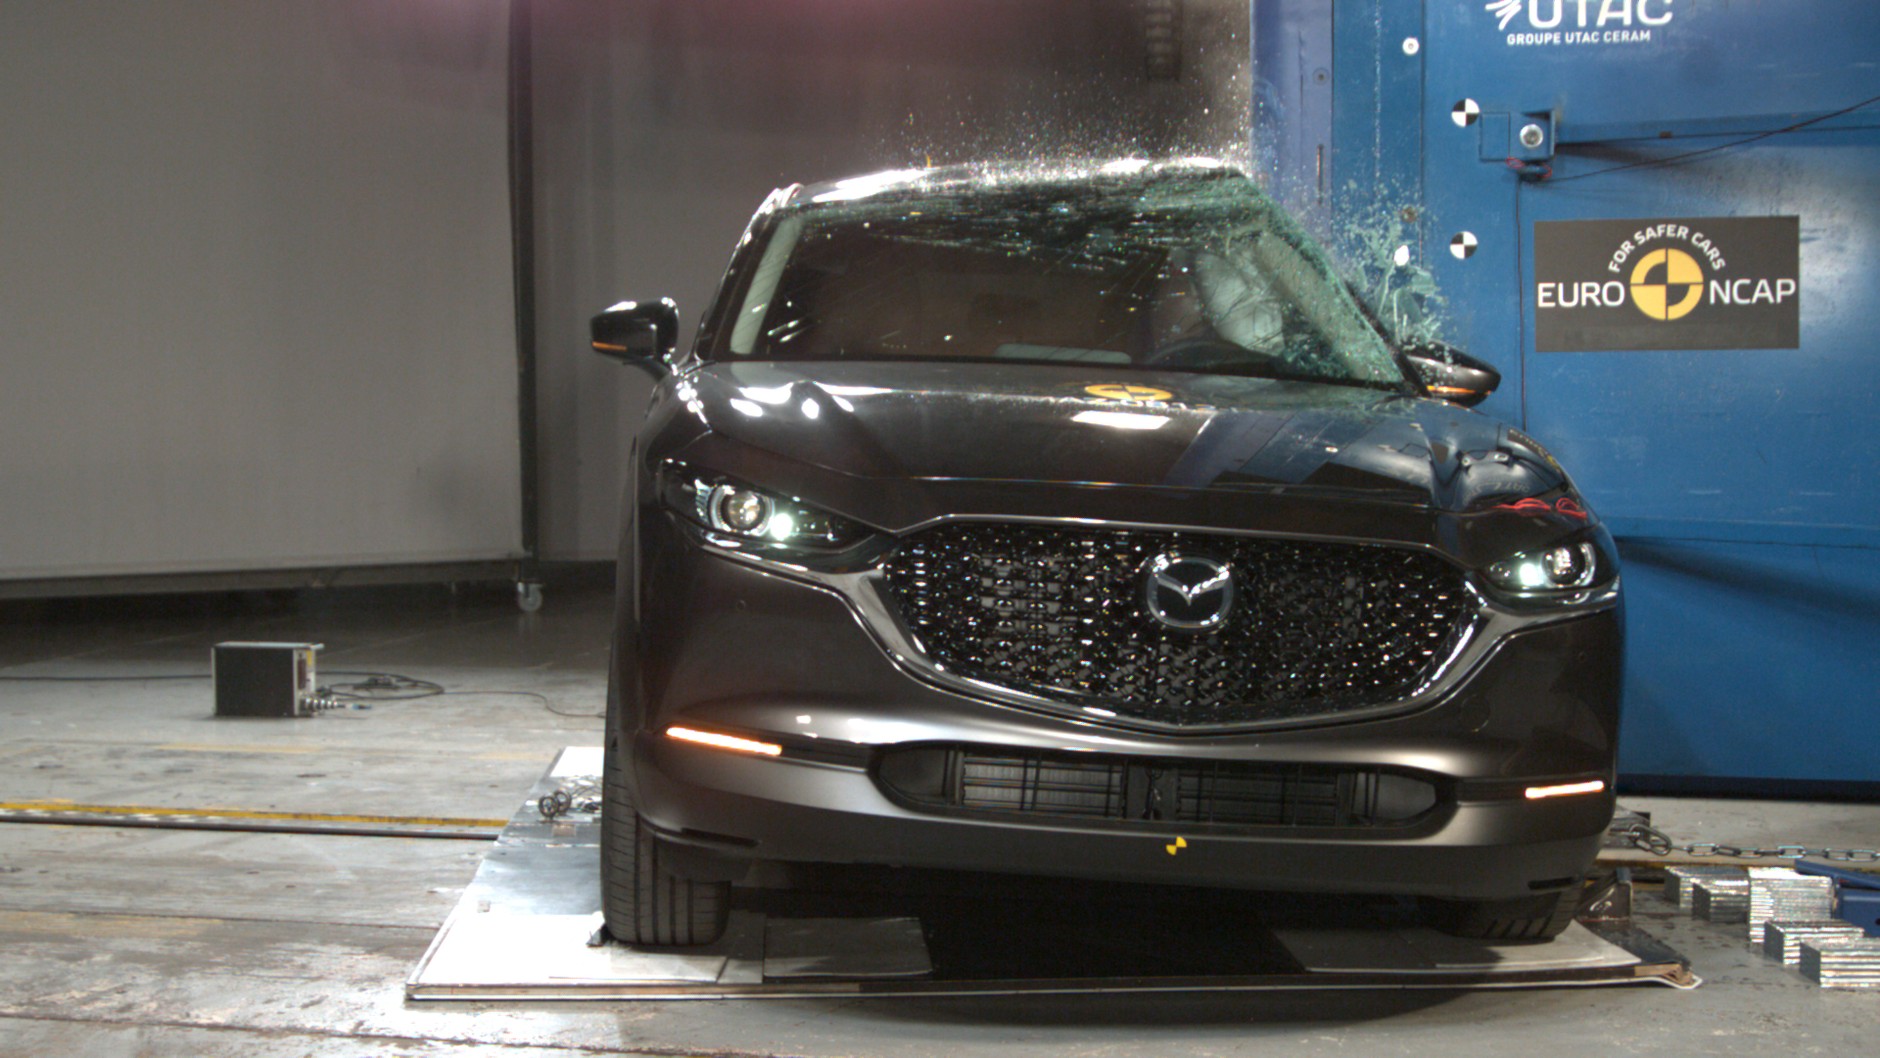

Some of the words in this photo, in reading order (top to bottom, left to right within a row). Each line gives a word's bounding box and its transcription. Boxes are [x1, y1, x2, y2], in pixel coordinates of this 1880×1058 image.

[1528, 0, 1673, 29] UTAC
[1506, 32, 1561, 46] GROUPE
[1564, 31, 1600, 44] UTAC
[1603, 29, 1651, 43] CERAM
[1608, 240, 1635, 273] FOR
[1633, 224, 1689, 246] SAFER
[1691, 232, 1726, 271] CARS
[1537, 281, 1625, 308] EURO
[1709, 279, 1796, 305] NCAP
